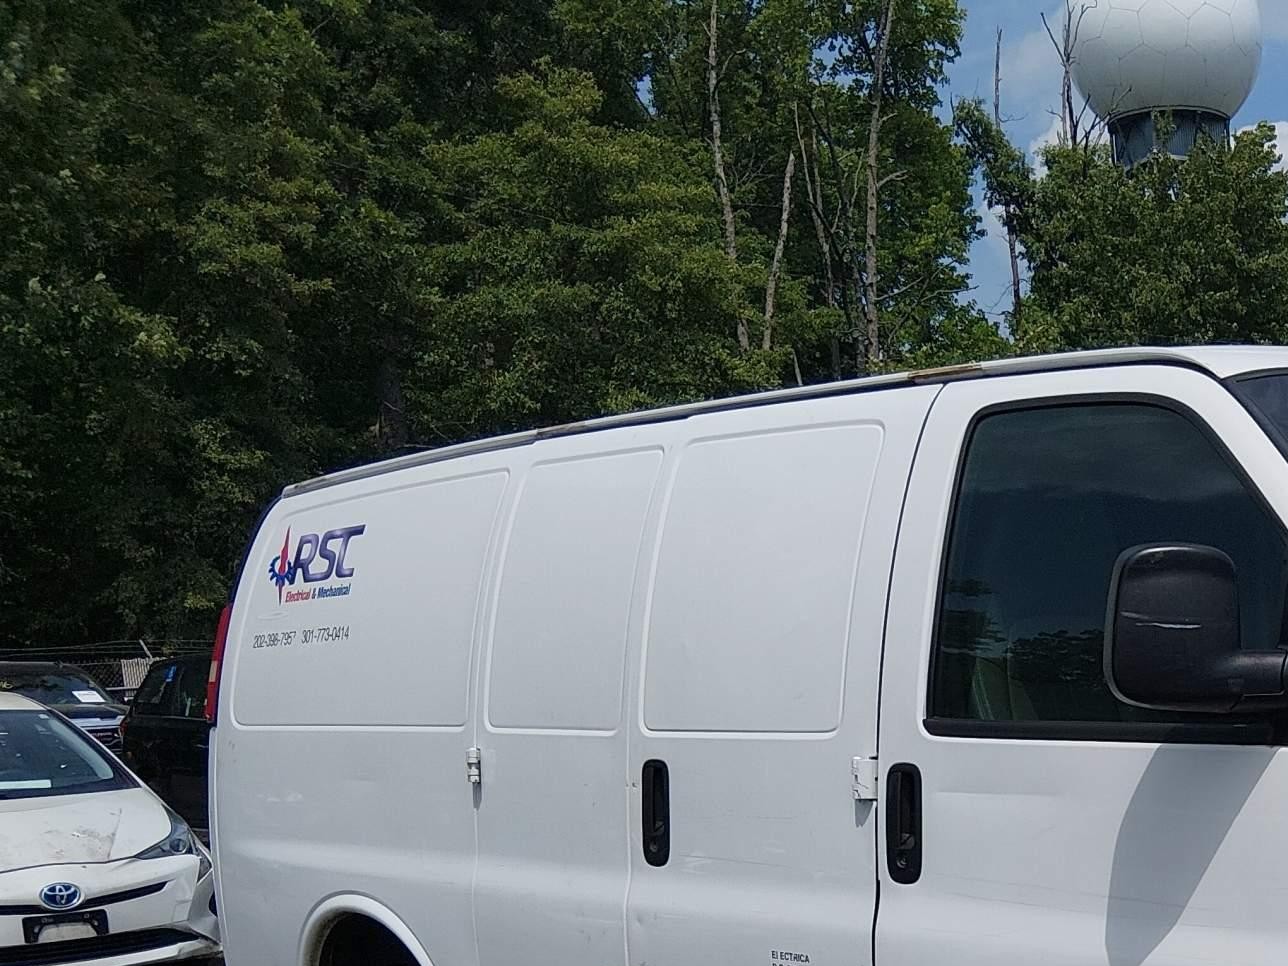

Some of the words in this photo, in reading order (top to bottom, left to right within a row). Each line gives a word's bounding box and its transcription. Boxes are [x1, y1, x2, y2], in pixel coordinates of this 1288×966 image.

[289, 524, 366, 585] RSC
[285, 588, 311, 603] Electrical
[317, 583, 351, 599] Mechanical
